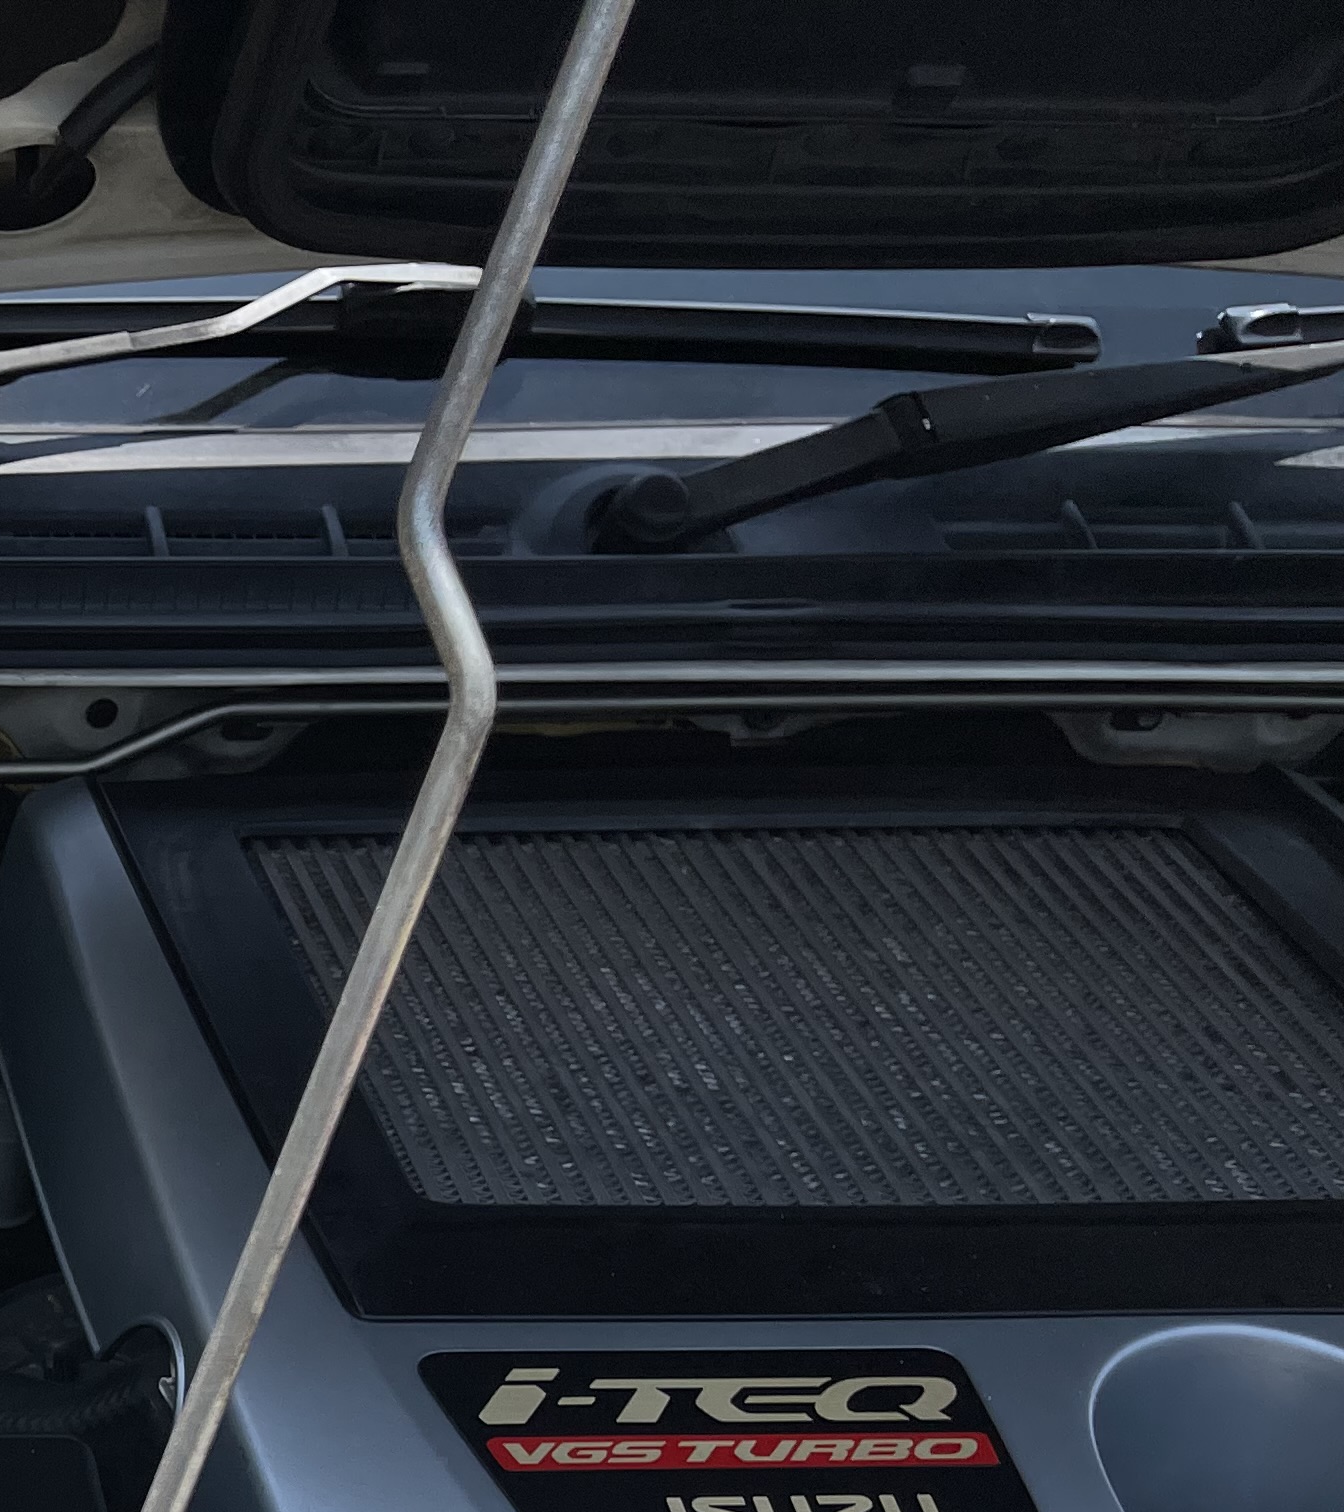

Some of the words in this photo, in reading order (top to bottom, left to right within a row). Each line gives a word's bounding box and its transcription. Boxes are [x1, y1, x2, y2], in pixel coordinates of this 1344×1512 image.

[478, 1367, 958, 1425] i-TEQ
[502, 1440, 667, 1466] VGS
[678, 1437, 979, 1464] TURBO
